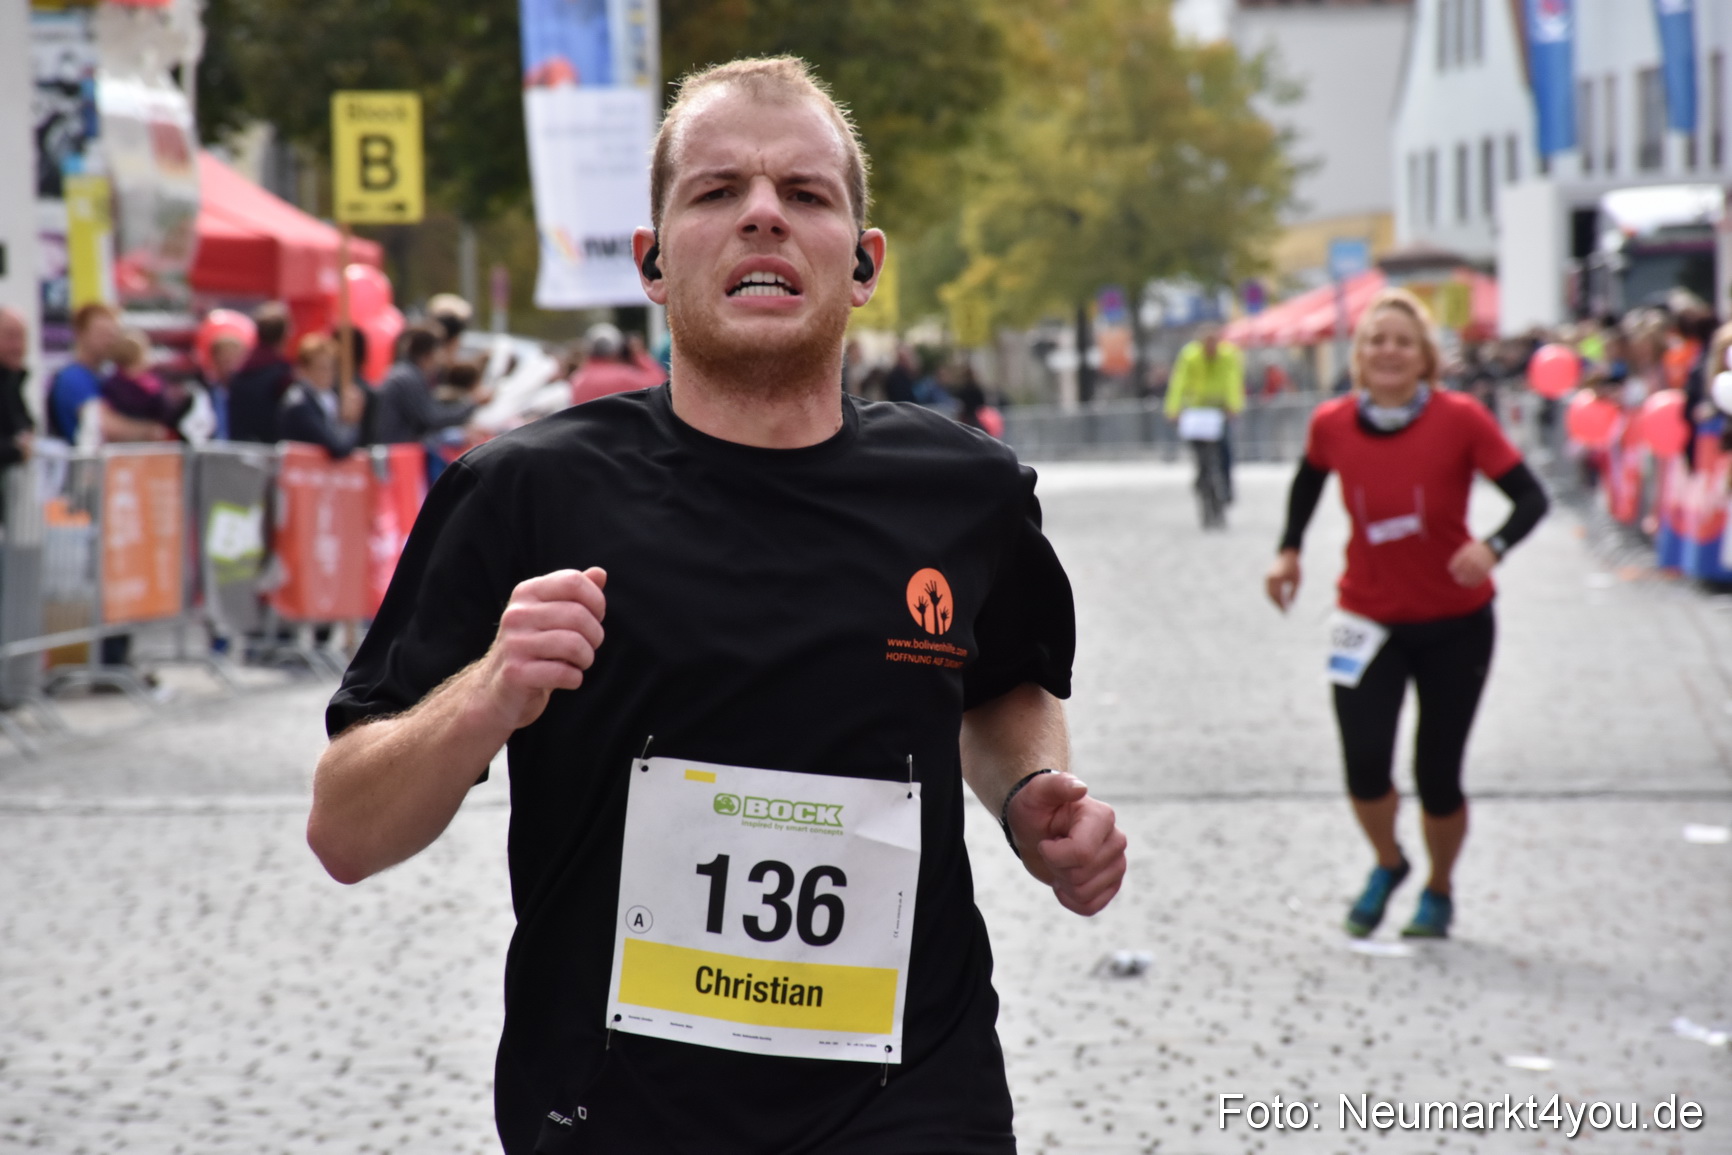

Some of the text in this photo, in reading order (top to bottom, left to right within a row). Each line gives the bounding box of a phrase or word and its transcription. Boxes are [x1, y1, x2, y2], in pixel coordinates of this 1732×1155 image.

[359, 134, 399, 192] B
[886, 653, 932, 664] HOFFNUNG
[743, 796, 844, 827] BOCK
[741, 820, 772, 829] inspired
[774, 823, 783, 831] by
[810, 827, 844, 836] concepts
[696, 853, 848, 947] 136
[633, 913, 644, 928] A
[695, 965, 824, 1007] Christian
